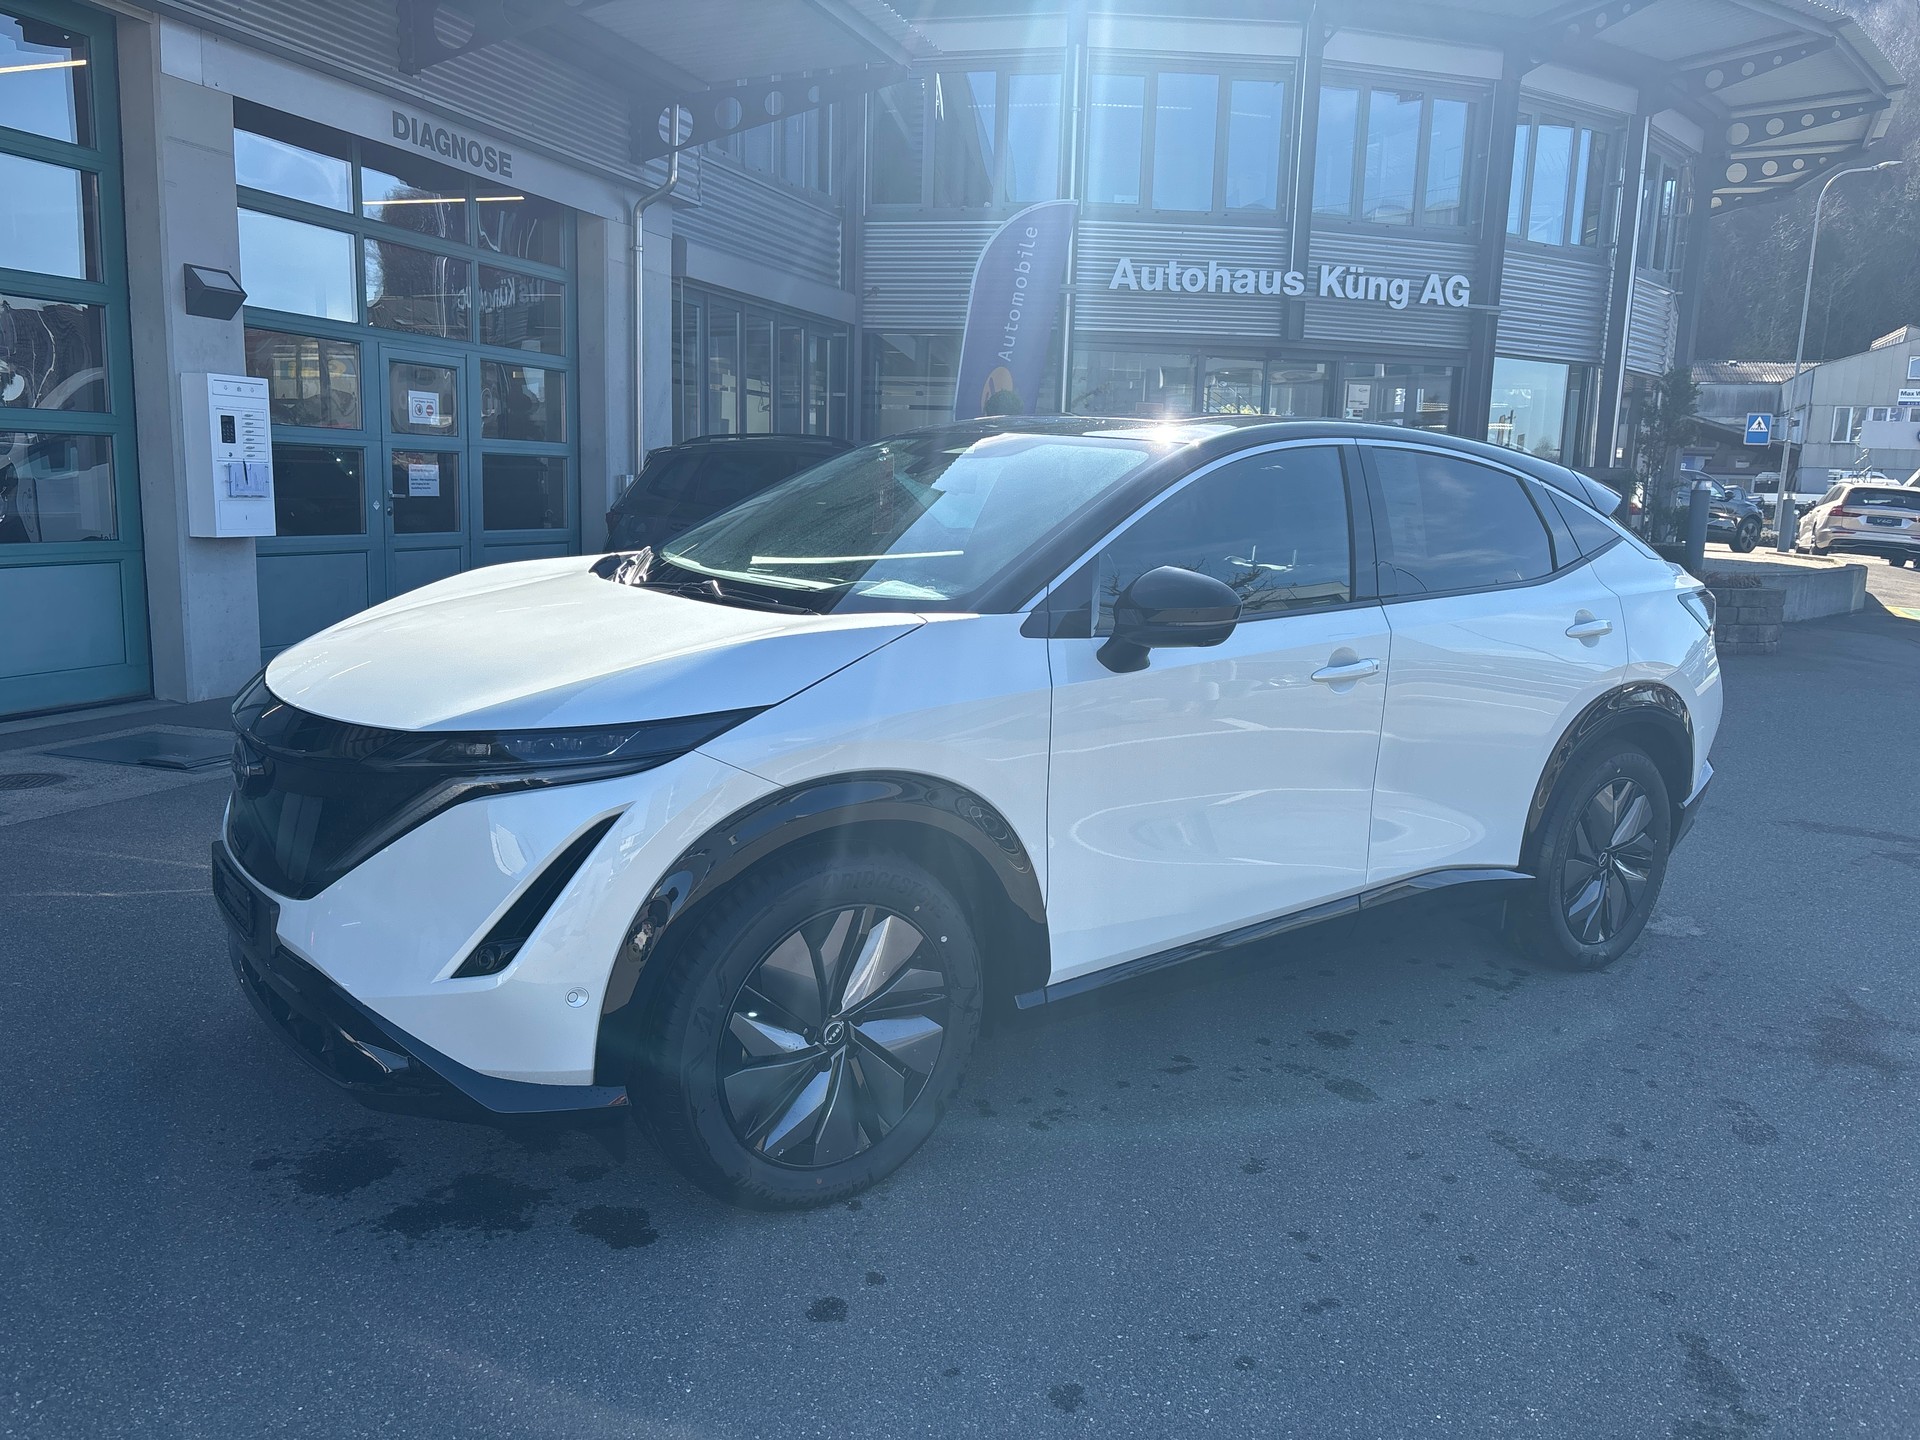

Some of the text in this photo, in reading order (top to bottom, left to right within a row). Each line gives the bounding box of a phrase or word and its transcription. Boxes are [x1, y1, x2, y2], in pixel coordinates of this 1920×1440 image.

[392, 110, 513, 179] DIAGNOSE
[997, 226, 1039, 363] Automobile
[1108, 257, 1472, 311] Autohaus Küng AG
